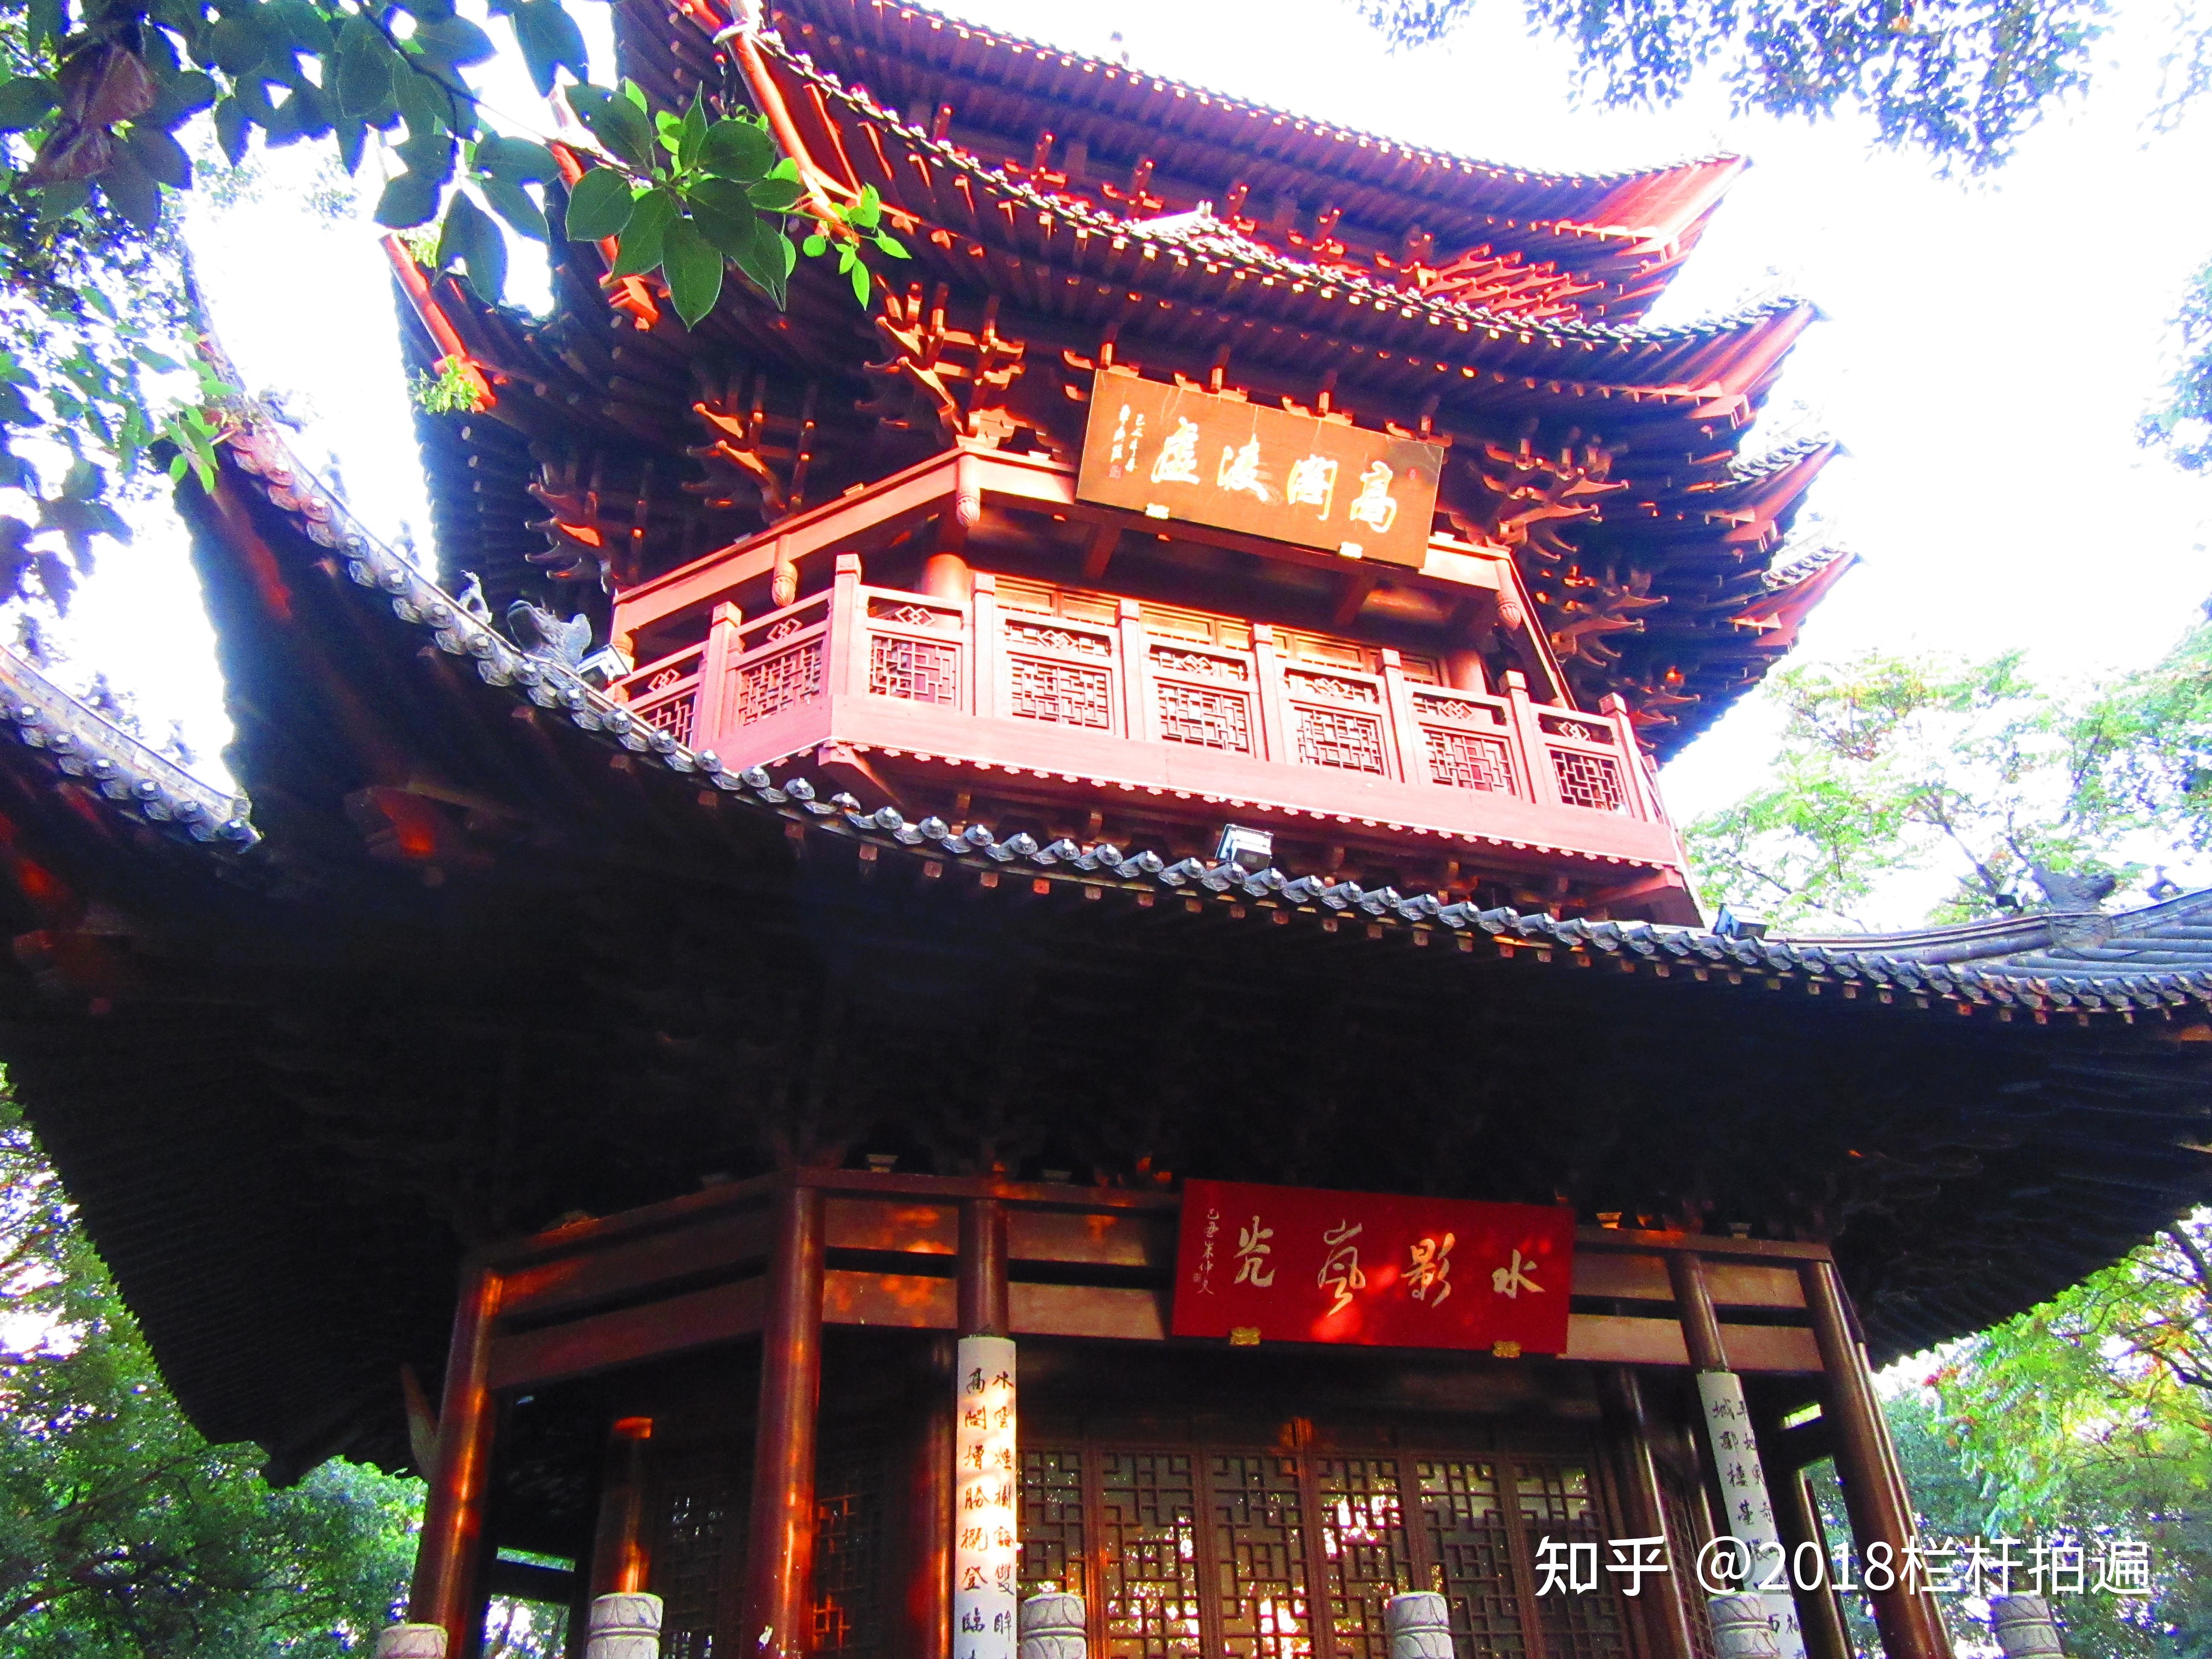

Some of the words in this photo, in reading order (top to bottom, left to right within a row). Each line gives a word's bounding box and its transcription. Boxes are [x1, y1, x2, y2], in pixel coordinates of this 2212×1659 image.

[960, 1367, 990, 1659] 高閣增勝概登臨
